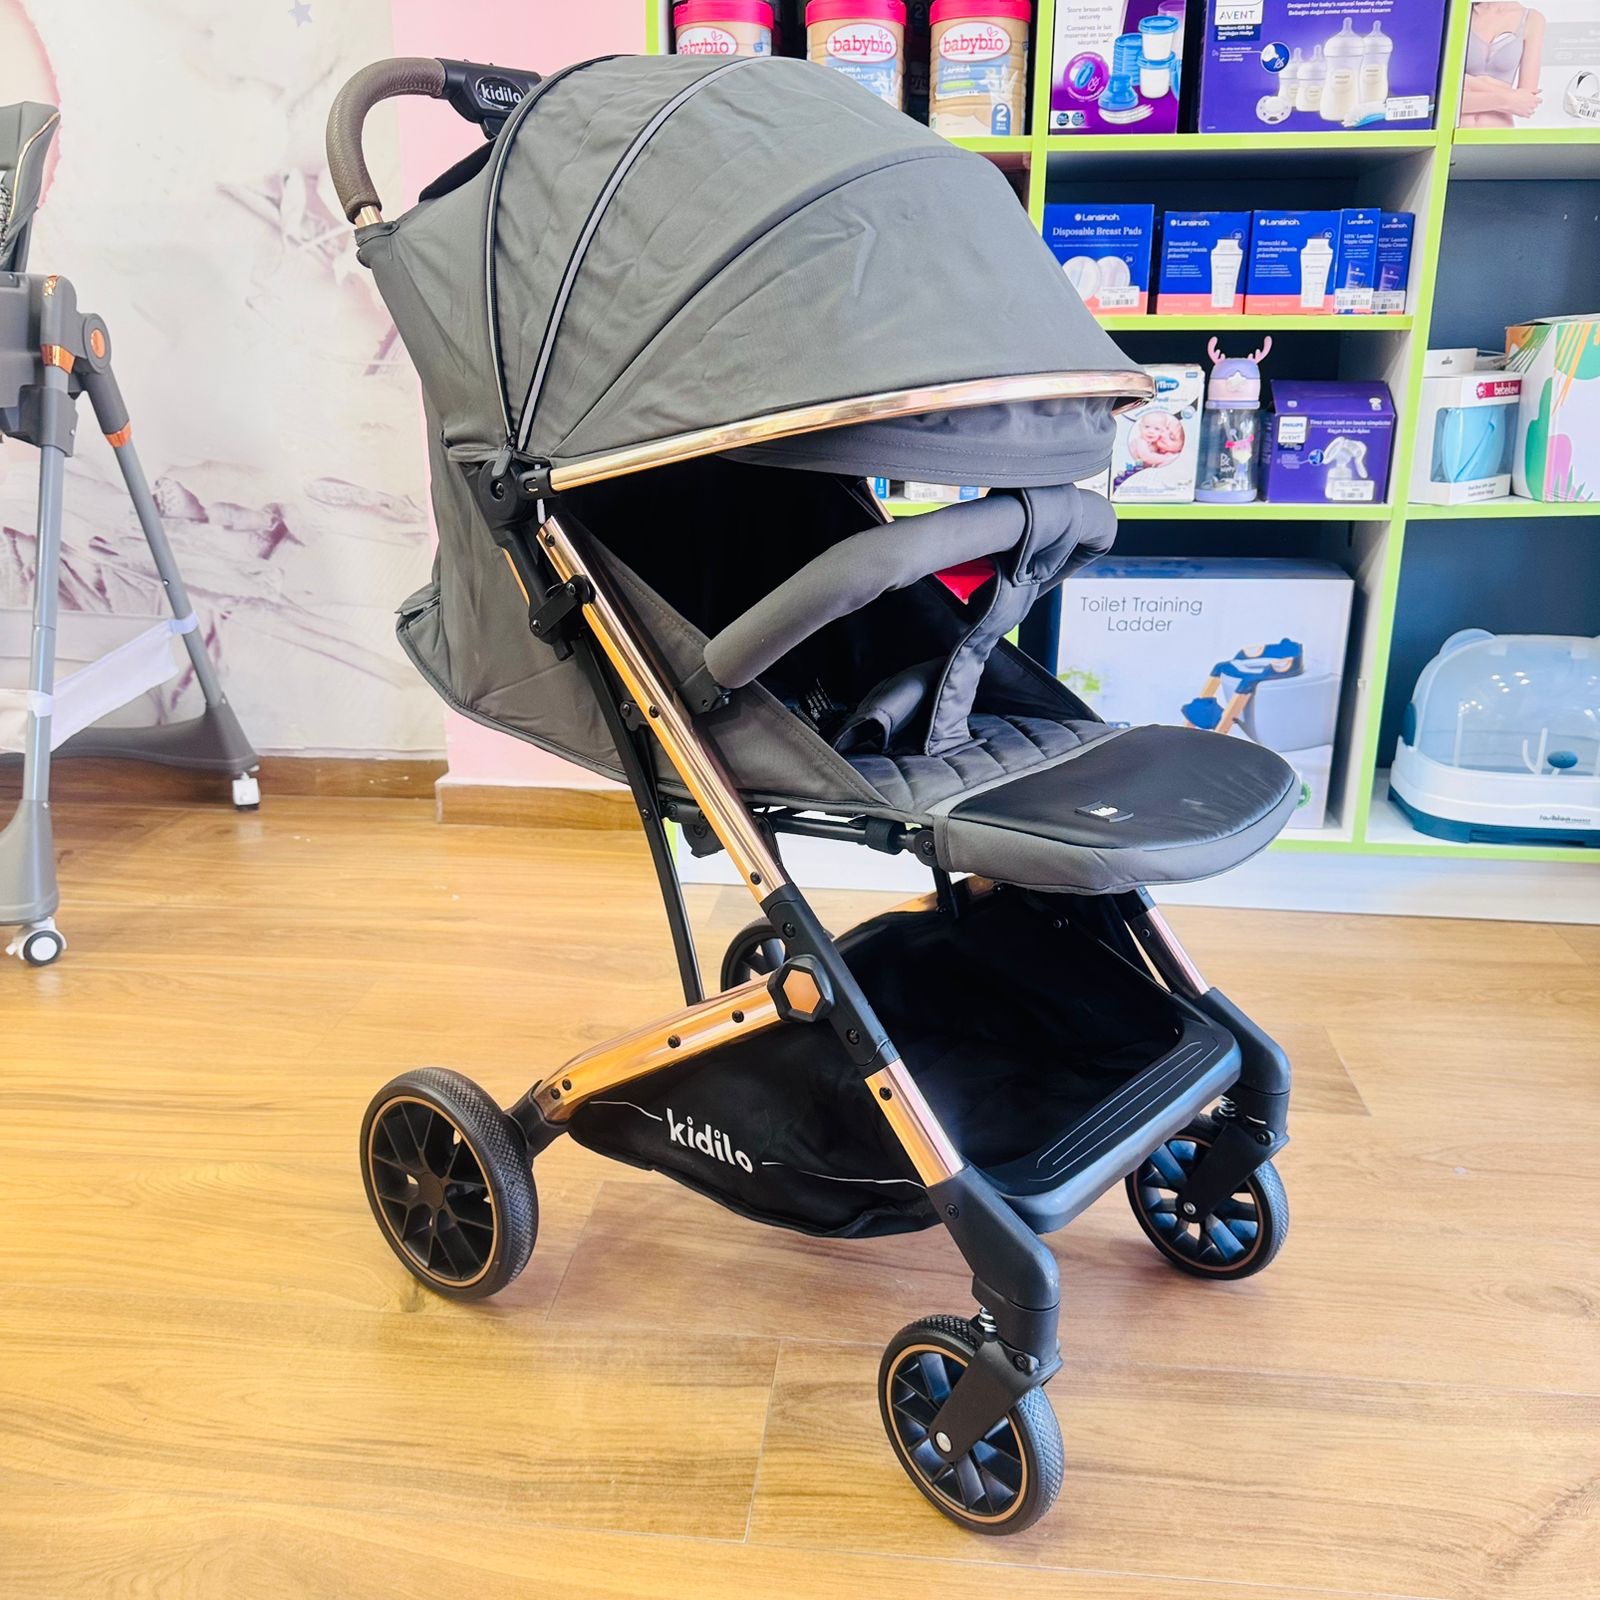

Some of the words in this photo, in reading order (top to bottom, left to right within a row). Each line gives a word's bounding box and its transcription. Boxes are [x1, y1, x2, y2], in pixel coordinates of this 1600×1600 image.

[1219, 10, 1255, 20] AVENT
[833, 35, 893, 56] babybio
[943, 34, 1004, 54] babybio
[480, 84, 522, 103] kidilo
[996, 105, 1007, 121] 2
[1082, 213, 1120, 221] Lansinoh
[1053, 226, 1095, 237] Disposable
[1096, 226, 1121, 236] Breast
[1123, 226, 1142, 235] Pads
[1080, 597, 1127, 612] Toilet
[1133, 597, 1203, 616] Training
[1107, 616, 1173, 632] Ladder
[666, 1107, 753, 1174] kidilo
